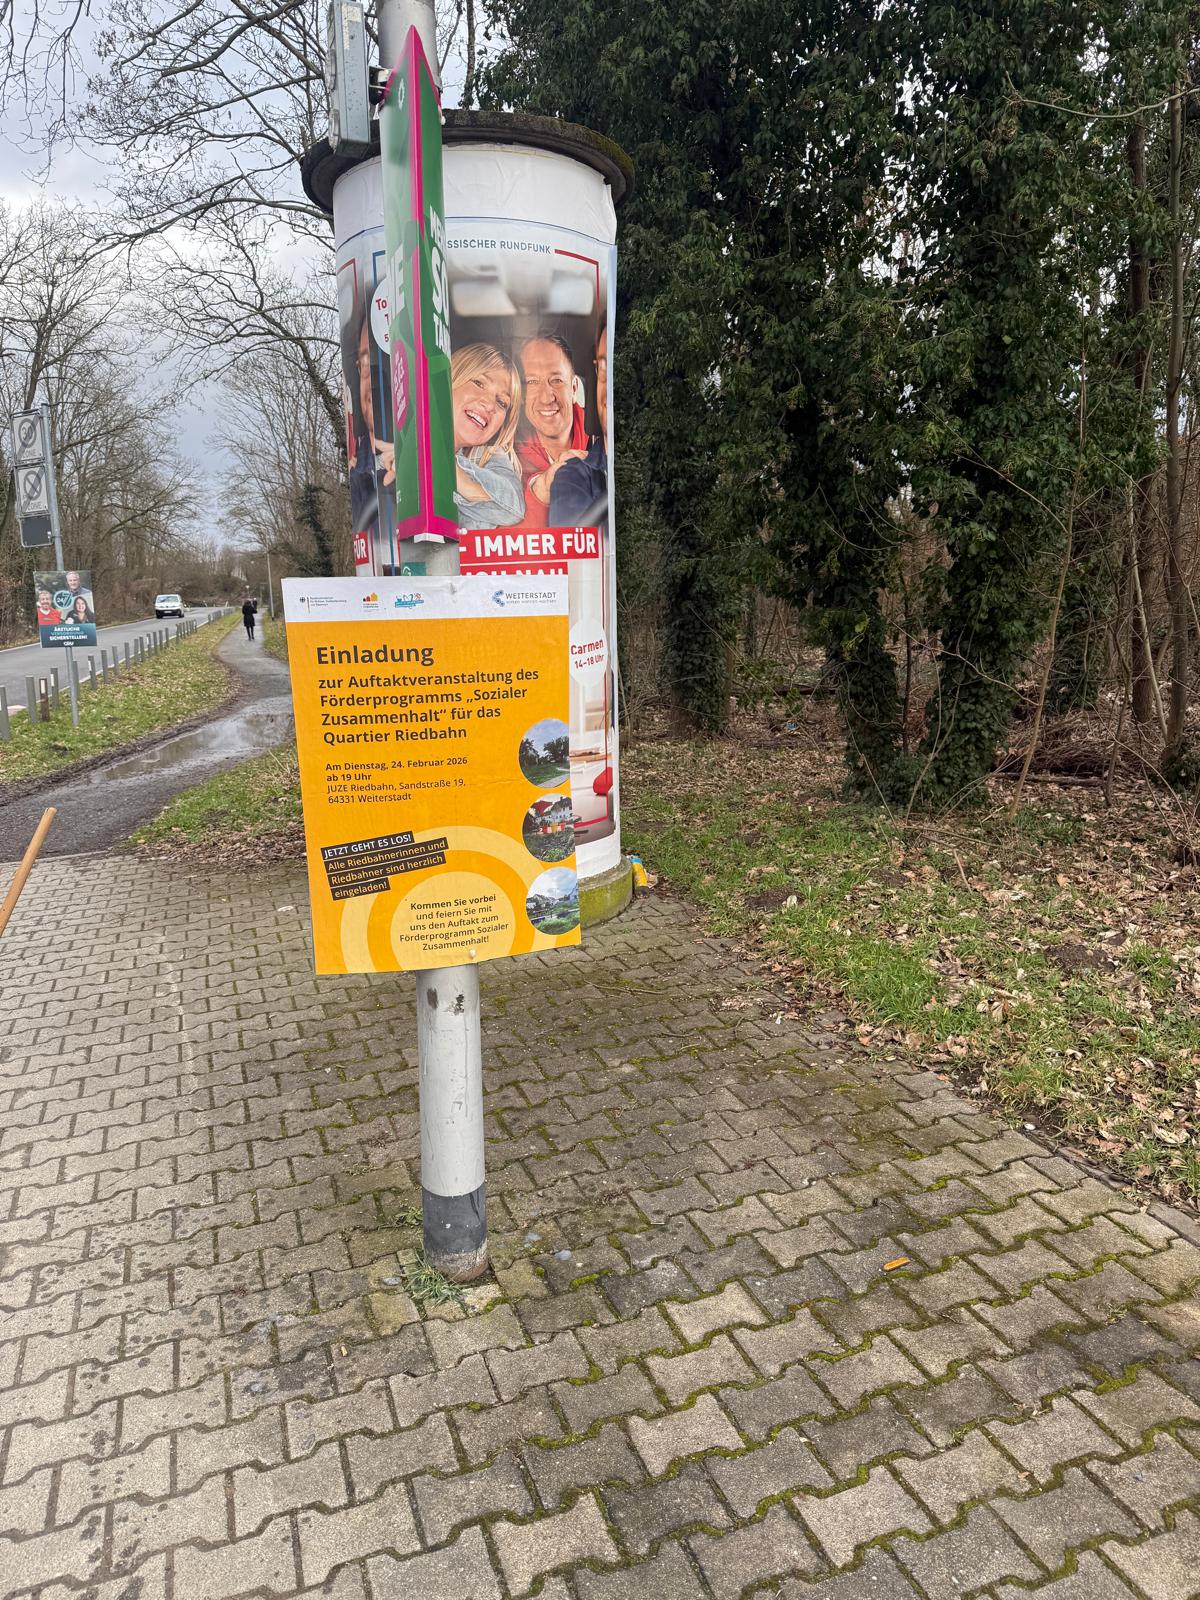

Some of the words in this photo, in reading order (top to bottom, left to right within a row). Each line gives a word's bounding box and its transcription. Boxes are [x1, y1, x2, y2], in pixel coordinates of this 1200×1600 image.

[447, 239, 496, 248] SSISCHER
[500, 240, 550, 254] RUNDFUNK
[475, 534, 556, 558] IMMER
[562, 528, 597, 555] FÜR
[317, 644, 434, 666] Einladung
[570, 639, 604, 656] Carmen
[595, 654, 604, 662] Uhr
[319, 679, 343, 688] zur
[348, 671, 513, 688] Auftaktveranstaltung
[516, 669, 539, 680] des
[320, 692, 462, 709] Förderprogramms
[450, 708, 472, 720] für
[477, 706, 501, 718] das
[323, 730, 390, 746] Quartier
[395, 727, 467, 741] Riedbahn
[344, 762, 388, 771] Dienstag,
[407, 759, 444, 768] Februar
[447, 757, 468, 765] 2026
[327, 785, 348, 794] JUZE
[350, 783, 396, 792] Riedbahn,
[399, 780, 451, 790] Sandstraße
[328, 795, 355, 804] 64331
[358, 793, 412, 803] Weiterstadt
[323, 848, 349, 859] JETZT
[351, 842, 376, 852] GEHT
[378, 839, 388, 848] ES
[391, 834, 412, 844] LOS!
[328, 860, 345, 871] Alle
[347, 847, 426, 867] Riedbahnerinnen
[428, 840, 446, 851] und
[331, 869, 384, 885] Riedbahner
[385, 863, 405, 874] sind
[407, 856, 443, 869] herzlich
[334, 881, 388, 897] eingeladen!
[410, 901, 452, 910] Kommen
[469, 894, 496, 904] vorbei
[416, 912, 433, 920] und
[436, 909, 462, 919] feiern
[478, 905, 492, 914] mit
[429, 922, 445, 930] den
[448, 917, 480, 928] Auftakt
[481, 915, 499, 923] zum
[400, 930, 475, 942] Förderprogramm
[477, 923, 509, 934] Sozialer
[422, 936, 489, 951] Zusammenhalt!
